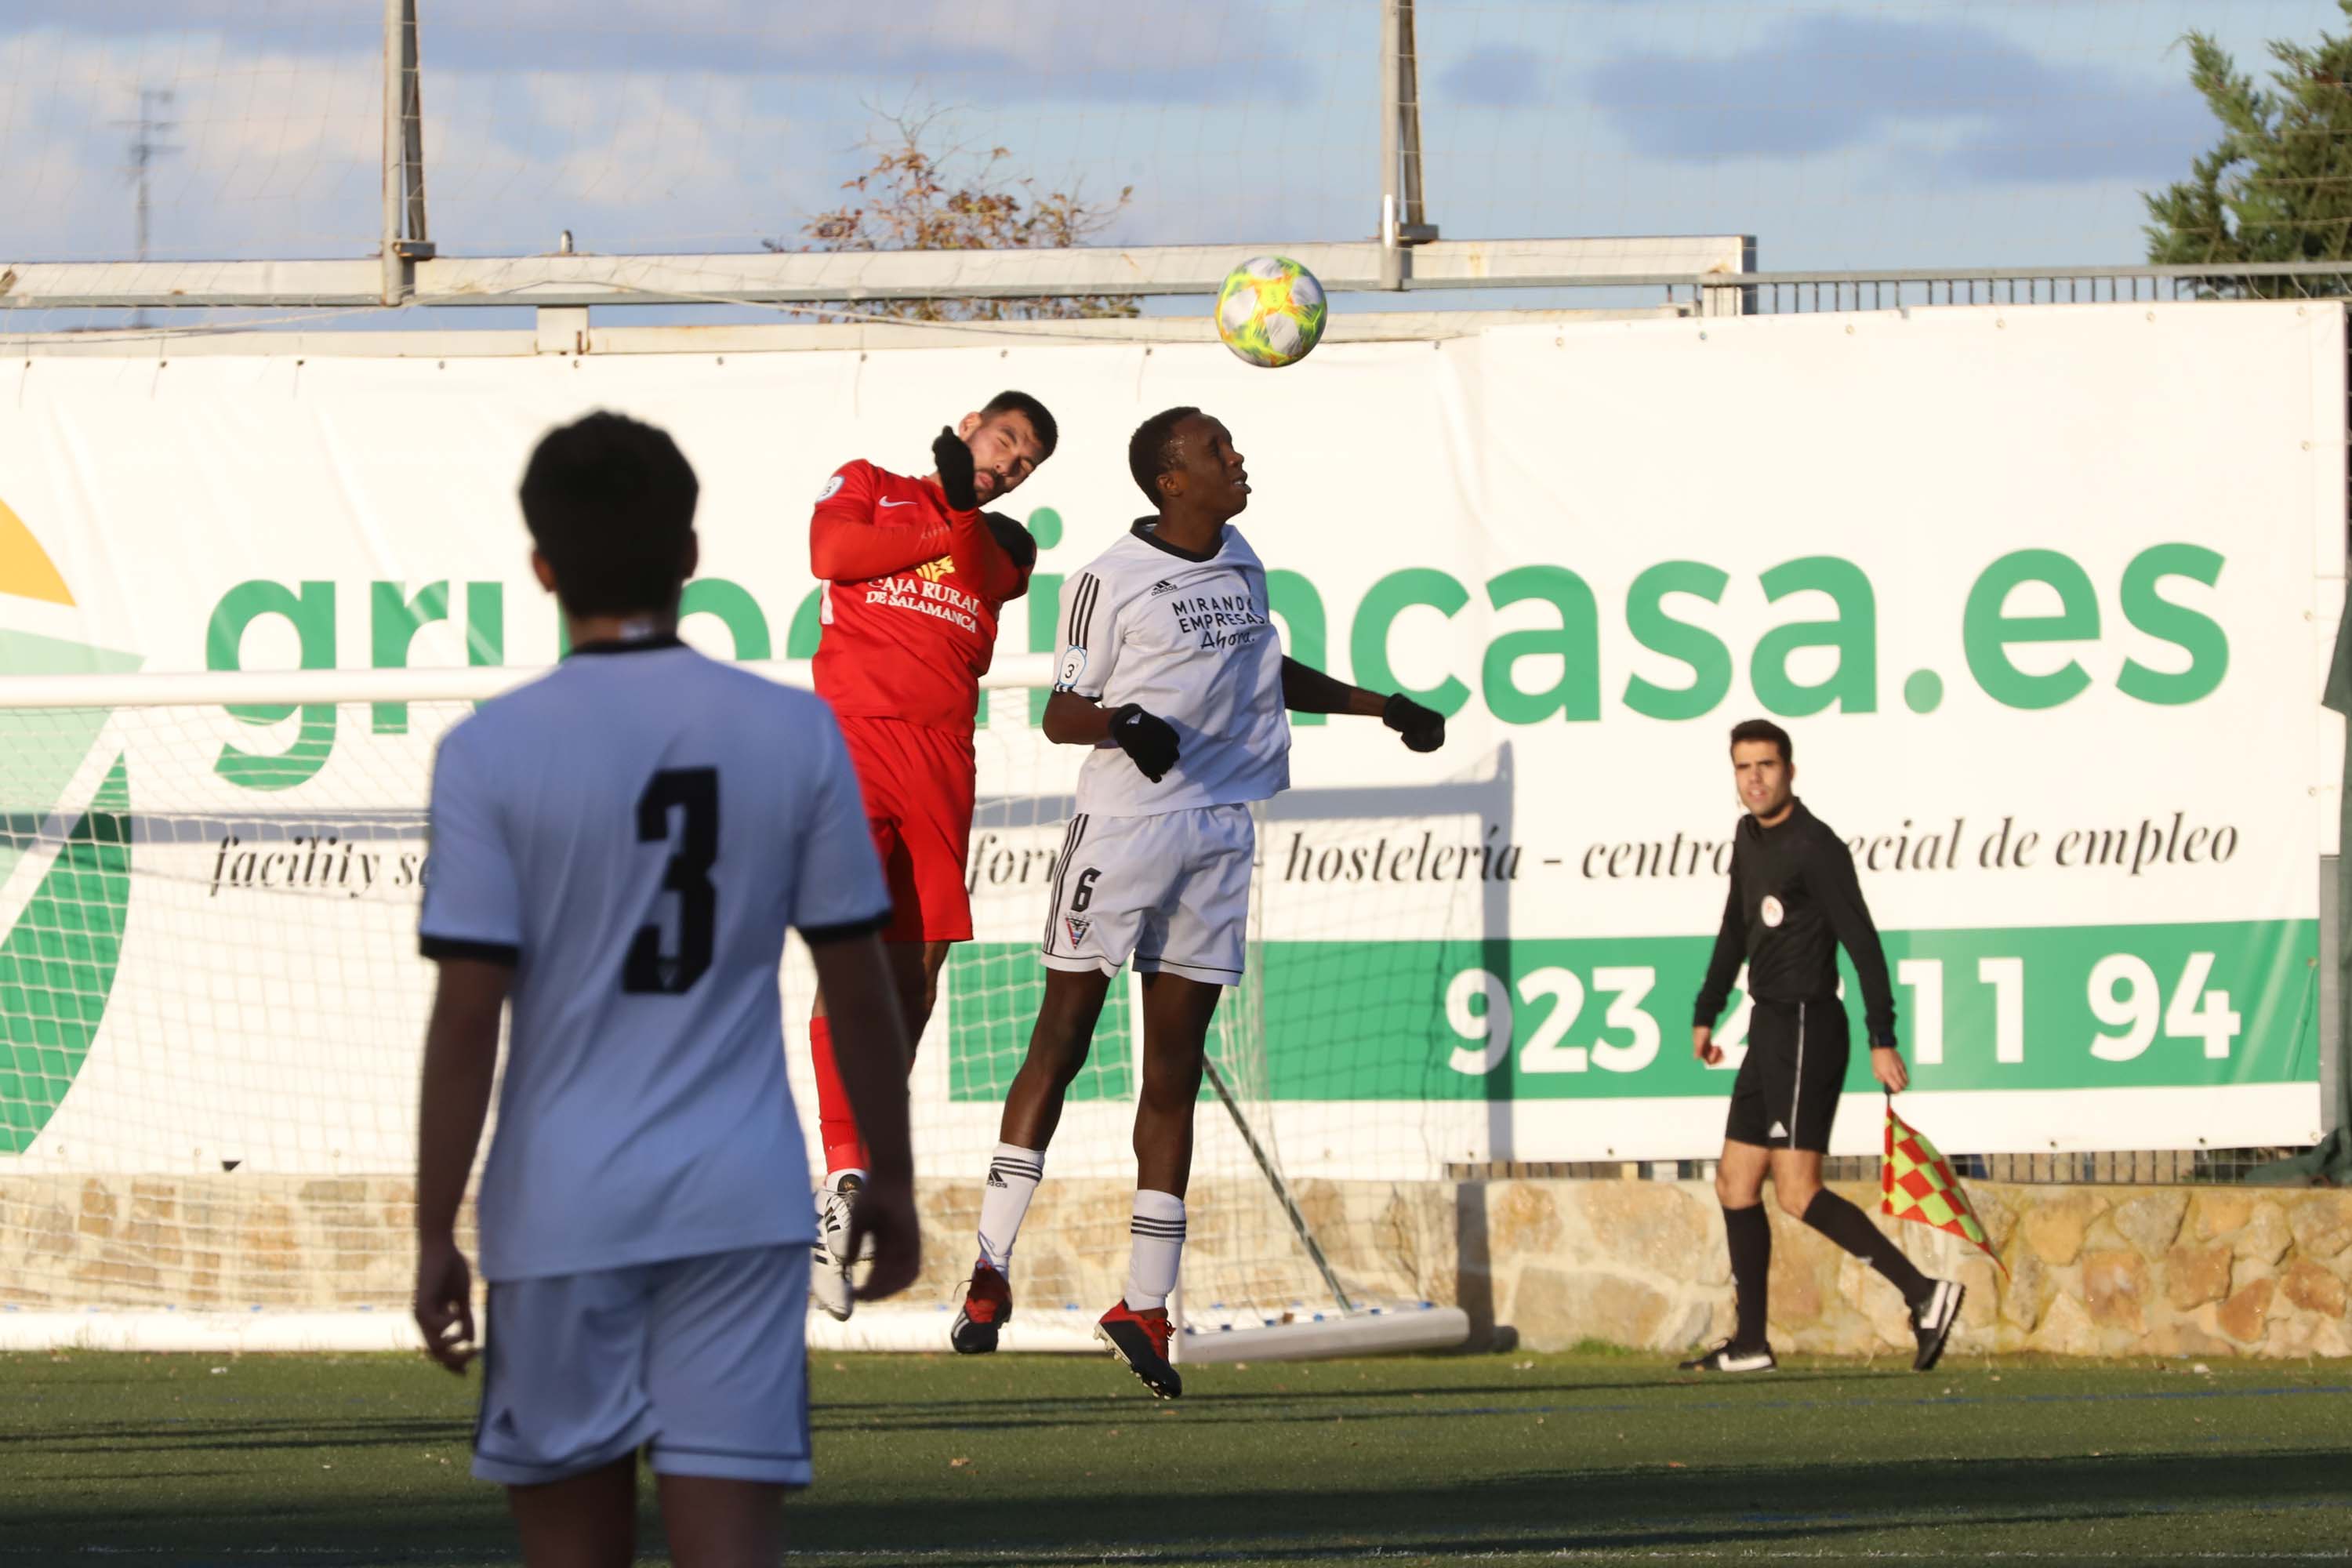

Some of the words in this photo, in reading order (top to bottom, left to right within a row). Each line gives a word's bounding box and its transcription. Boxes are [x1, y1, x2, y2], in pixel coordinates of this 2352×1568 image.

[866, 590, 887, 605] DE
[887, 595, 977, 633] SALAMANCA
[920, 580, 980, 616] RURAL
[1178, 612, 1265, 633] EMPRESAS
[1065, 663, 1075, 678] 3
[209, 835, 379, 898] facility
[1284, 826, 1523, 881] hostelería
[1582, 832, 1734, 879] centro
[1846, 817, 1965, 871] ecial
[1978, 815, 2041, 869] de
[2055, 811, 2238, 877] empleo
[622, 764, 719, 996] 3
[1071, 867, 1102, 913] 6
[1445, 966, 1661, 1076] 923
[1897, 957, 2024, 1065] 11
[2086, 952, 2241, 1062] 94
